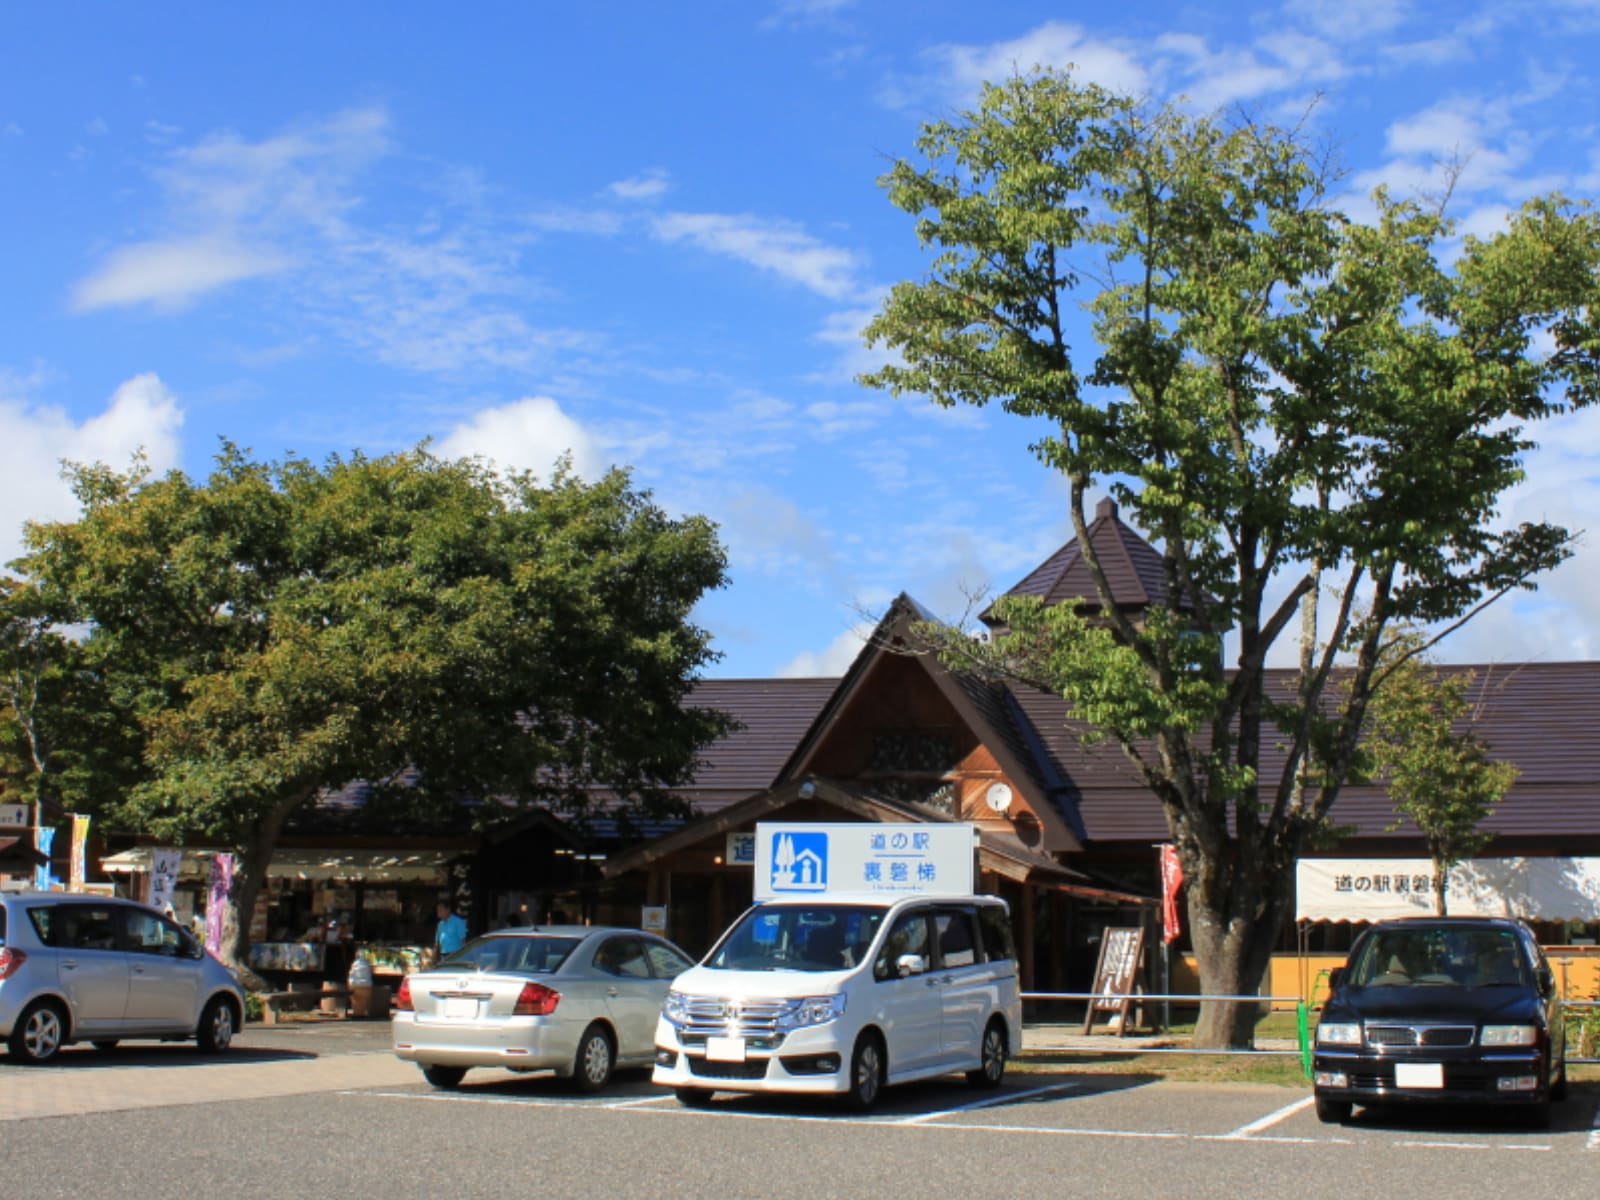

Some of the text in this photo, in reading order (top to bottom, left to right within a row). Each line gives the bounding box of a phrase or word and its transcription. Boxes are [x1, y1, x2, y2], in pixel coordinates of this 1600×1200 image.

[871, 832, 930, 850] 道の駅
[864, 862, 936, 882] 裏磐梯
